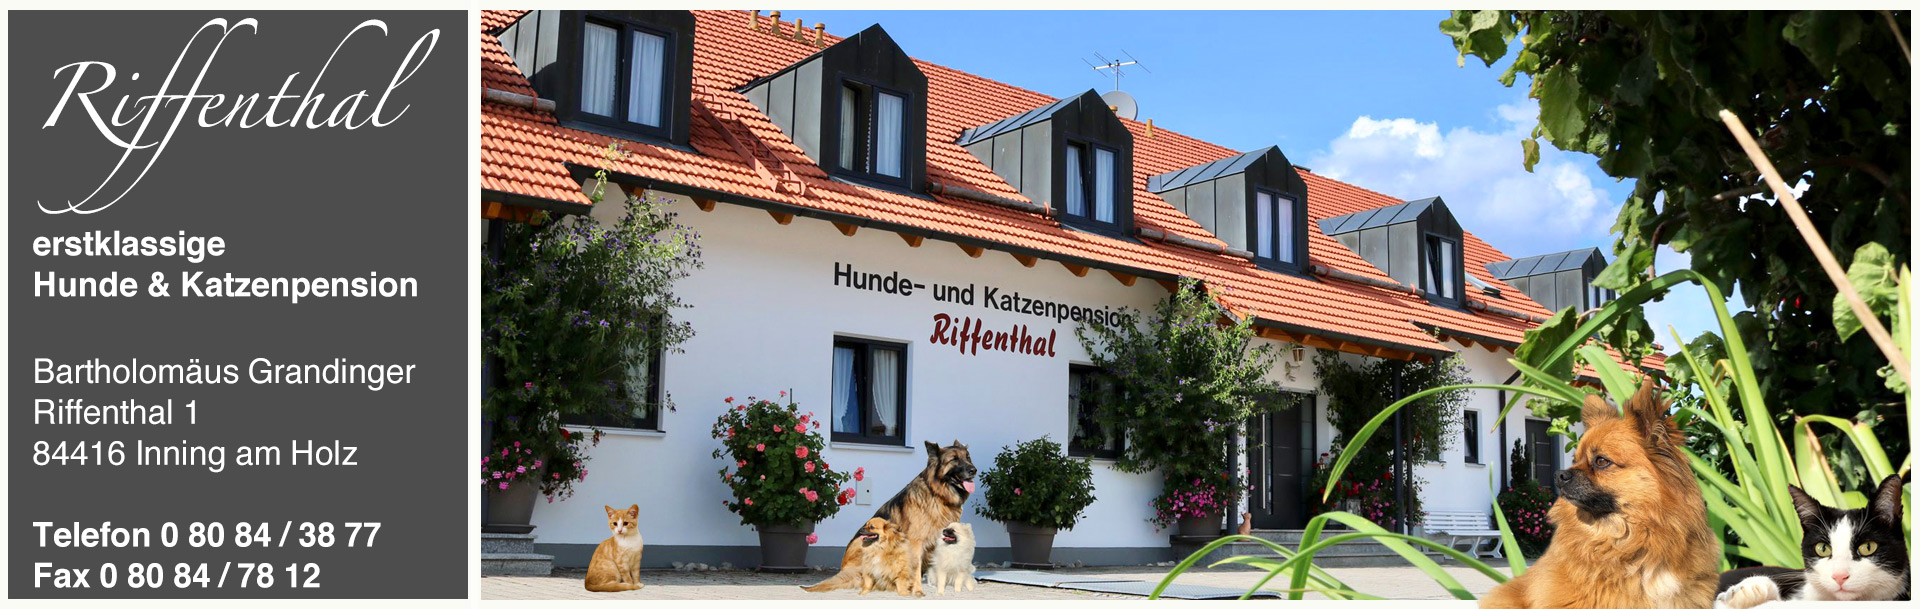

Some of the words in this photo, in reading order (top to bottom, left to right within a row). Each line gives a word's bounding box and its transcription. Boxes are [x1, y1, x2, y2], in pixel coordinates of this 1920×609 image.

[833, 261, 926, 297] Hunde-
[932, 283, 975, 306] und
[929, 312, 1056, 358] Riffenthal
